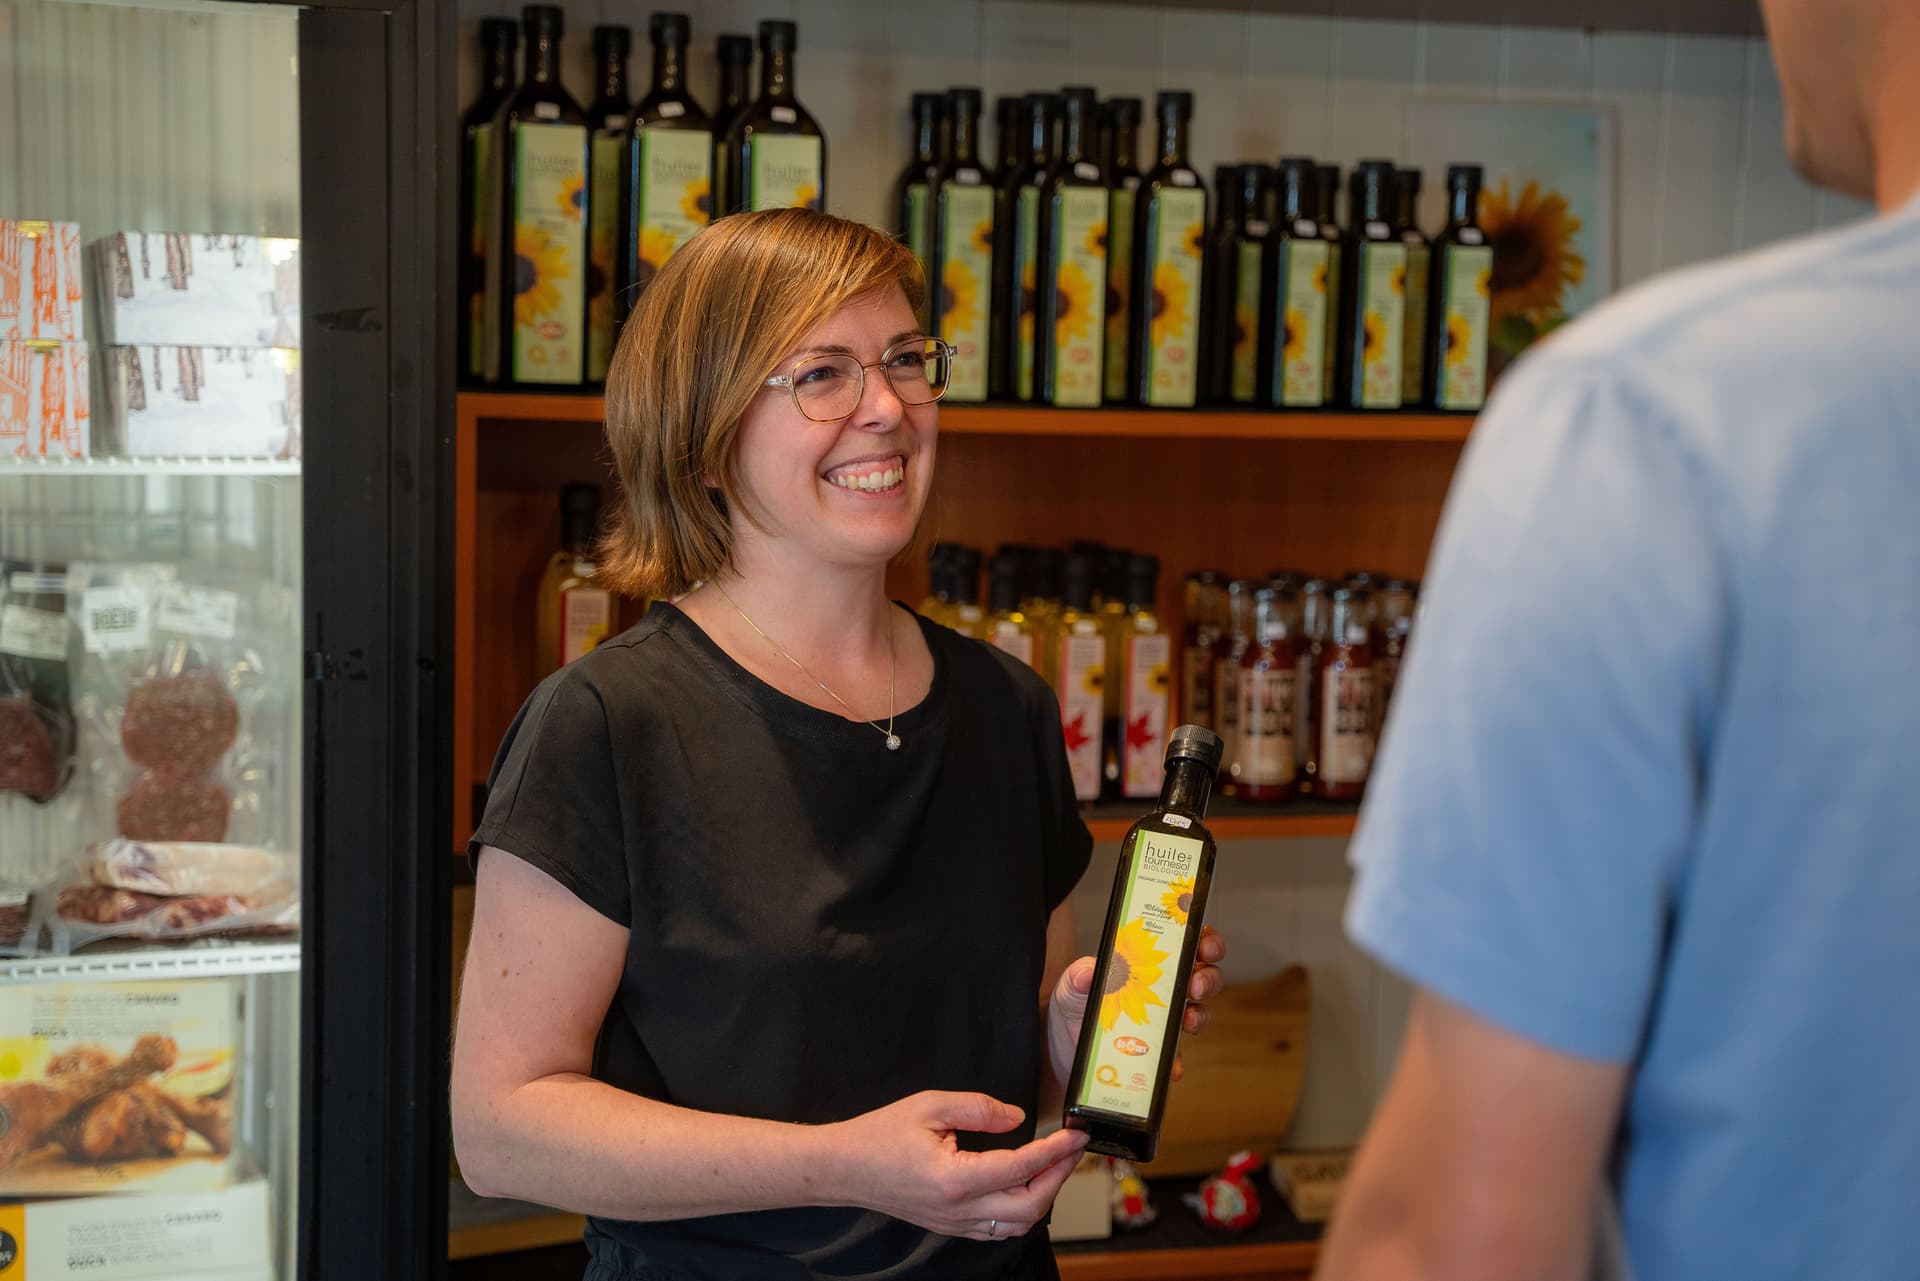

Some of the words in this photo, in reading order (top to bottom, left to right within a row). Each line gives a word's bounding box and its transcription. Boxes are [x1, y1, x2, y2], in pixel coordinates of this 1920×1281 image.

[1145, 841, 1187, 863] huile
[1143, 864, 1189, 877] BIOLOGIQUE
[1144, 855, 1191, 872] tournesol
[1102, 1096, 1120, 1106] 500
